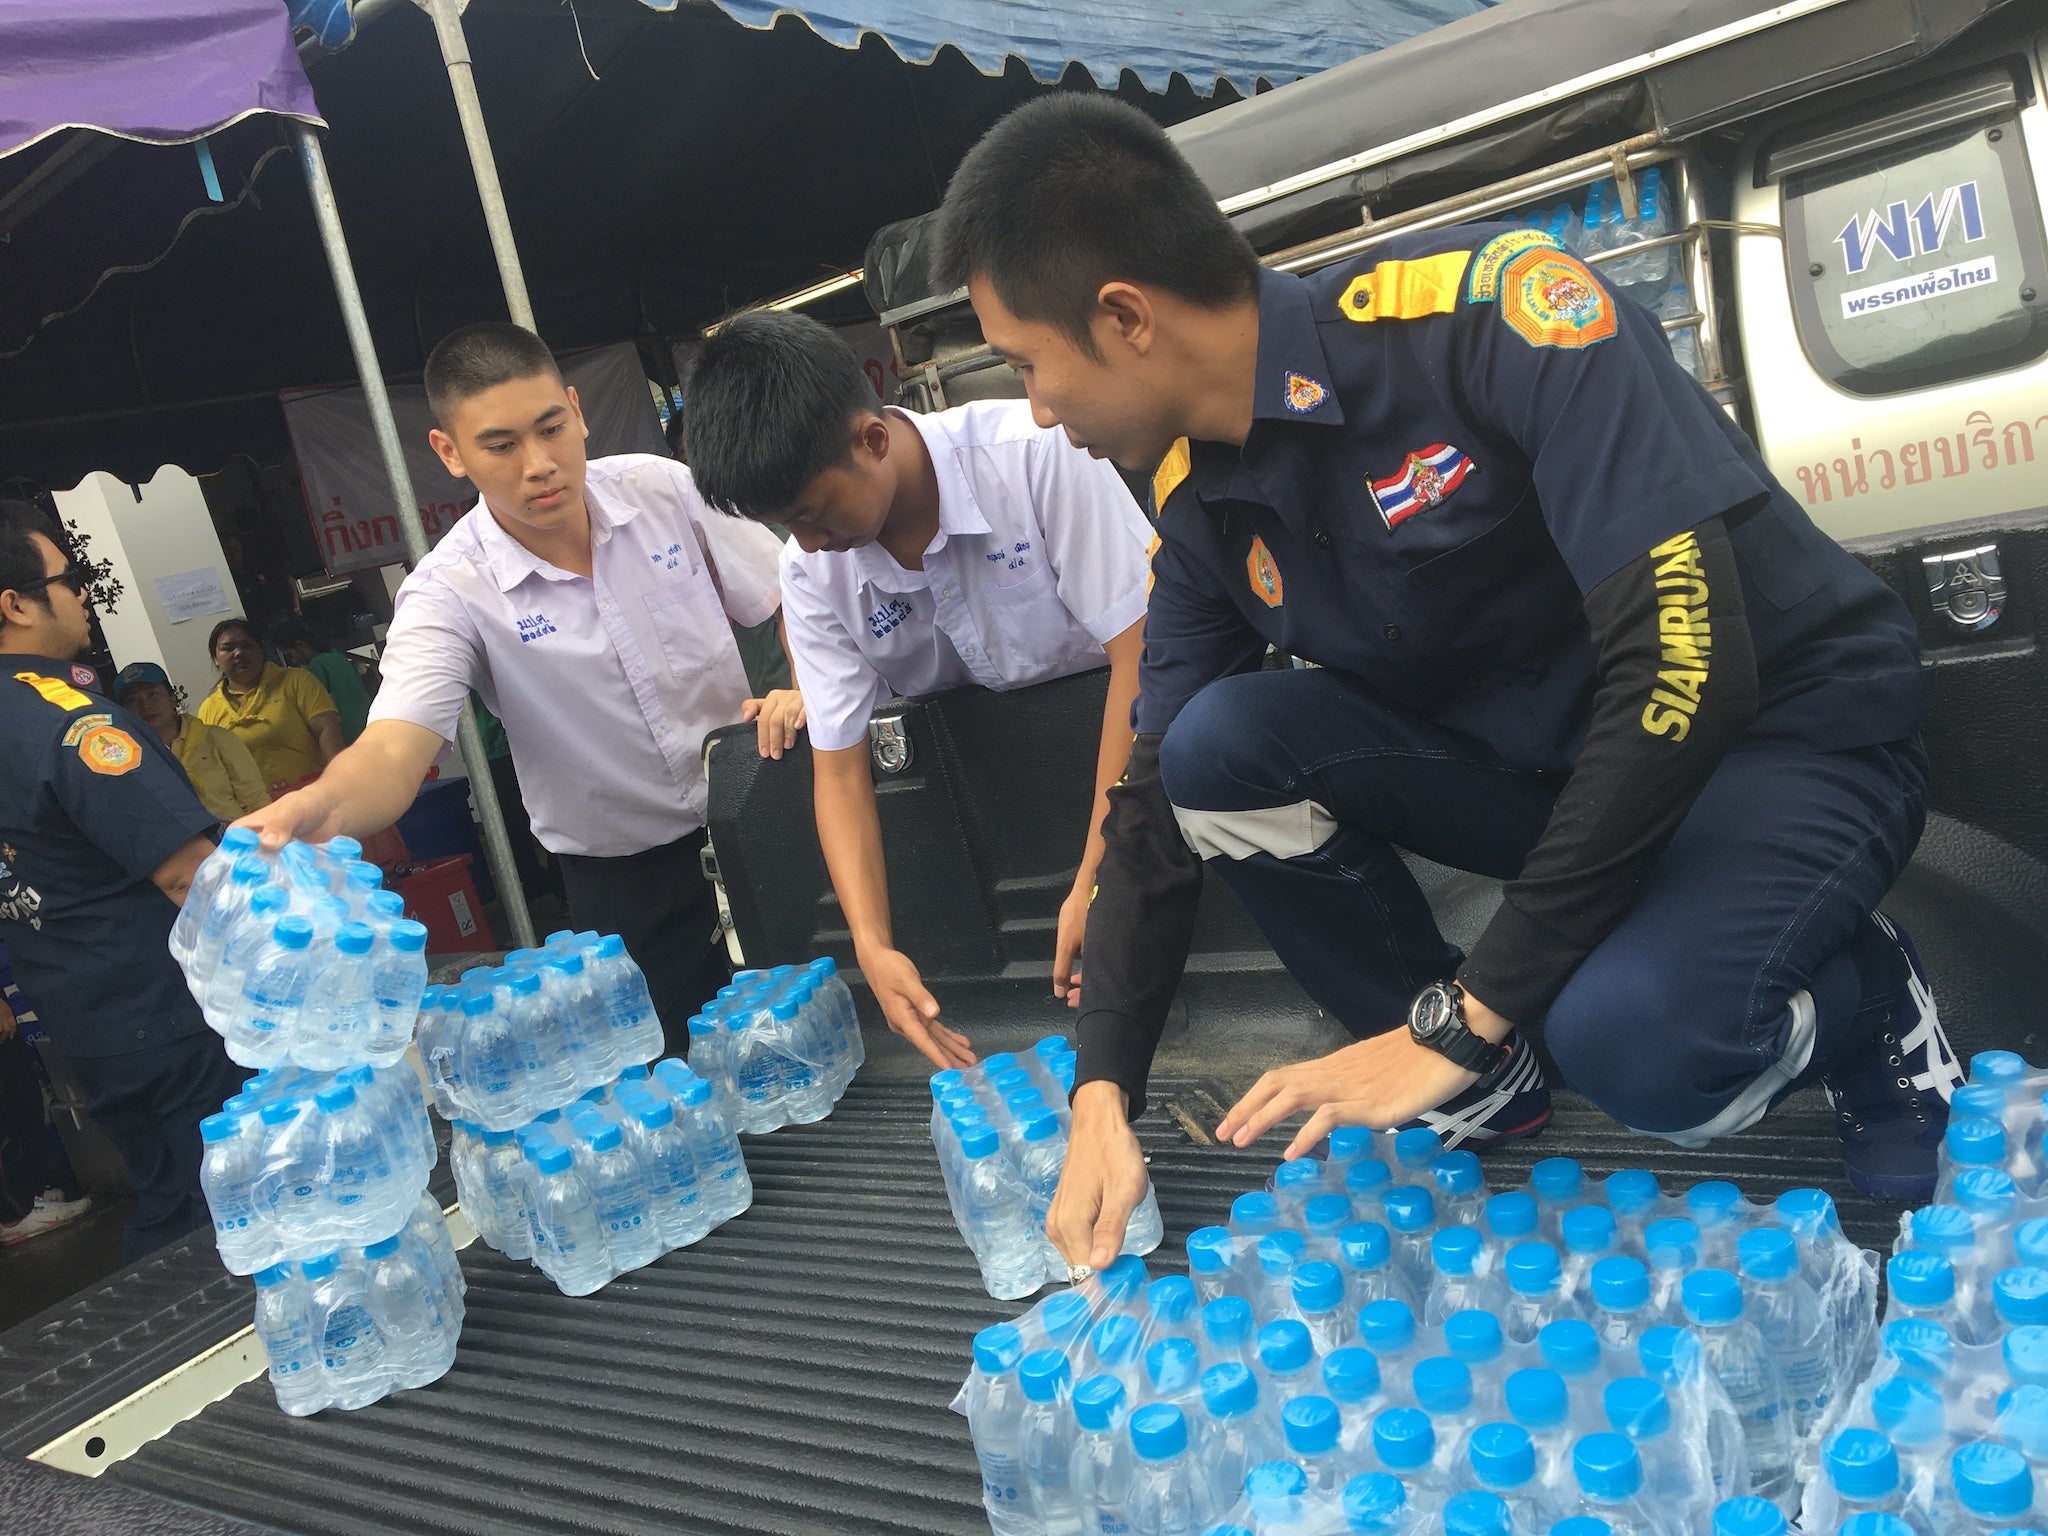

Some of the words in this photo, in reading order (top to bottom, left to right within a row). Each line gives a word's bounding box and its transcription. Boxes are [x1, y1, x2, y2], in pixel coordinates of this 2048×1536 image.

[1847, 265, 1992, 313] พรรคเพื่อไทย
